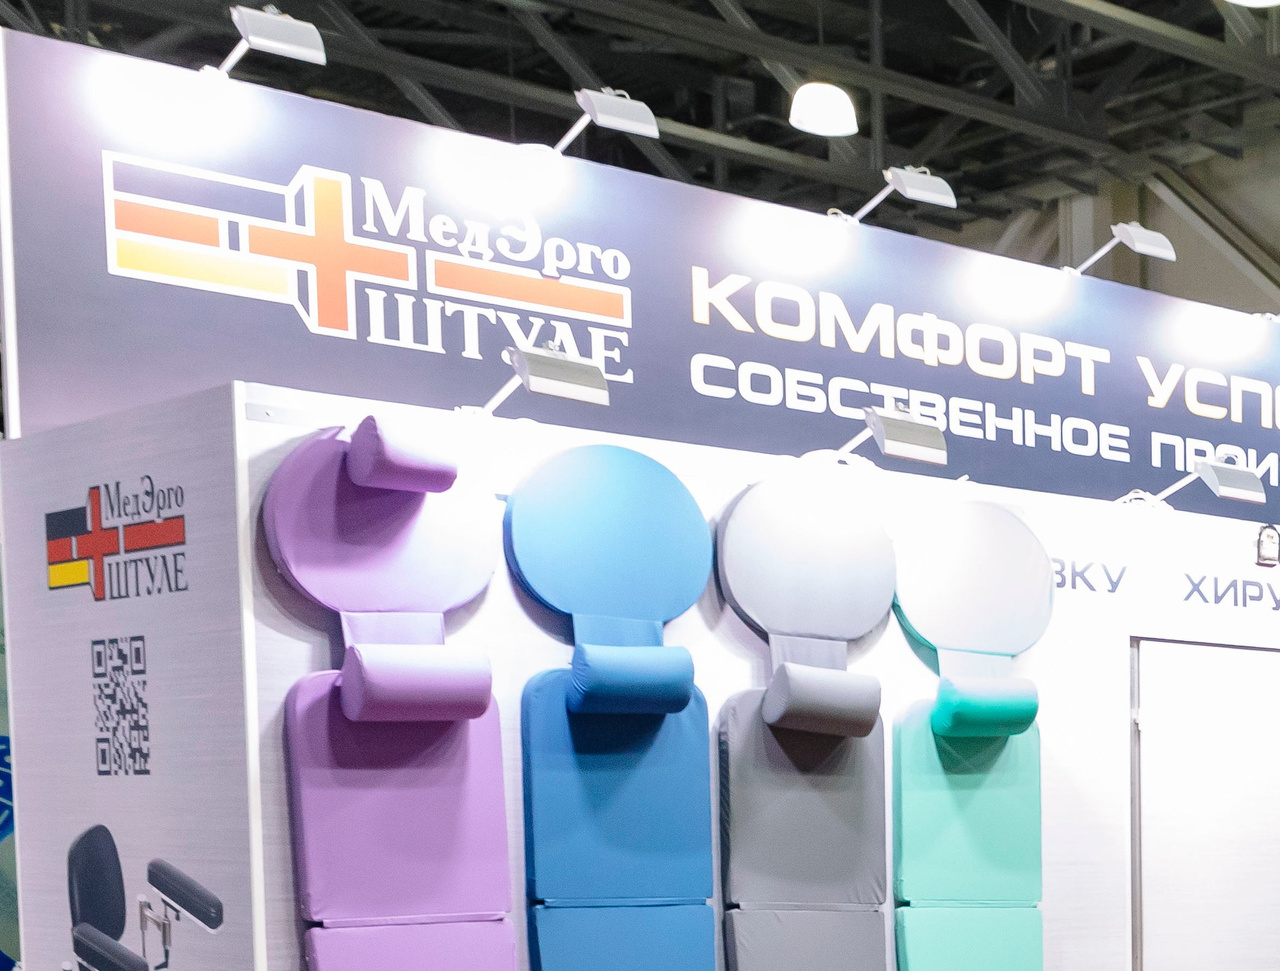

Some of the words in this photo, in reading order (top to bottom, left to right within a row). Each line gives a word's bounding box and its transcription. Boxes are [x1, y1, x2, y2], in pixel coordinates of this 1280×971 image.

[360, 175, 632, 279] МедЭрго
[691, 265, 1111, 396] КОМФОРТ
[689, 352, 1131, 463] СОБСТВЕННОЕ
[103, 474, 185, 521] МедЭрго
[107, 552, 189, 600] ШТУЛЕ
